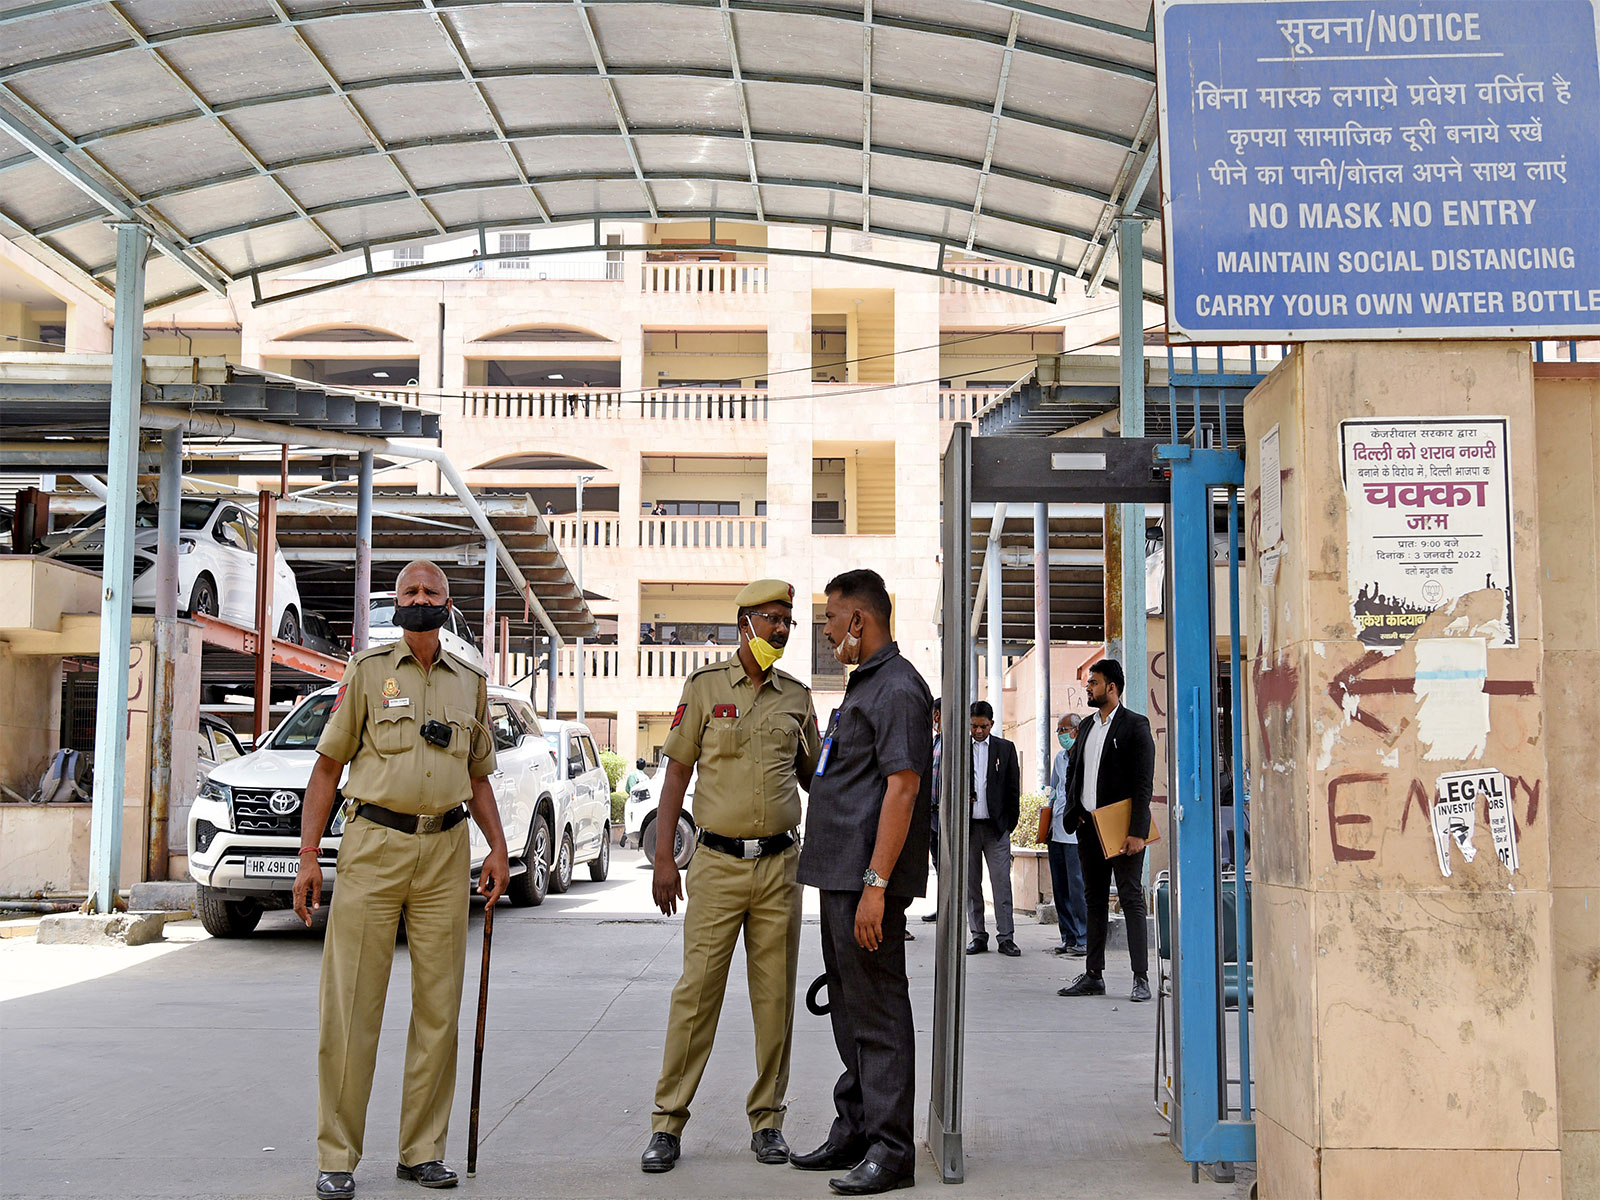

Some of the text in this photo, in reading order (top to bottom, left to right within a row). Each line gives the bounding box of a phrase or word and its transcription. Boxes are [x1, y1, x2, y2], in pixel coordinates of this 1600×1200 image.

[1195, 72, 1571, 110] बिना मास्क लगाये प्रवेश वर्जित है
[1227, 116, 1543, 155] कृपया सामाजिक दूरी बनाये रखें
[1208, 154, 1567, 191] पीने का पानी/बोतल अपने साथ लाएं
[1249, 199, 1536, 229] NO MASK NO ENTRY
[1217, 247, 1575, 273] MAINTAIN SOCIAL DISTANCING
[1195, 290, 1600, 316] CARRY YOUR OWN WATER BOTTLE
[1370, 427, 1477, 439] केजरीवाल सरकार द्वारा
[1353, 442, 1392, 460] दिल्ली
[1396, 442, 1416, 460] को
[1459, 440, 1496, 459] नगरी
[1358, 466, 1379, 477] बनाने
[1382, 464, 1390, 476] के
[1430, 463, 1452, 476] दिल्ली
[1455, 466, 1480, 476] भाजपा
[1363, 481, 1489, 508] चक्का
[1414, 552, 1420, 560] 3
[1423, 549, 1454, 559] जनवरी
[1458, 550, 1481, 559] 2022
[1420, 540, 1441, 548] 9:00
[252, 861, 265, 872] HR
[267, 861, 286, 873] 49H
